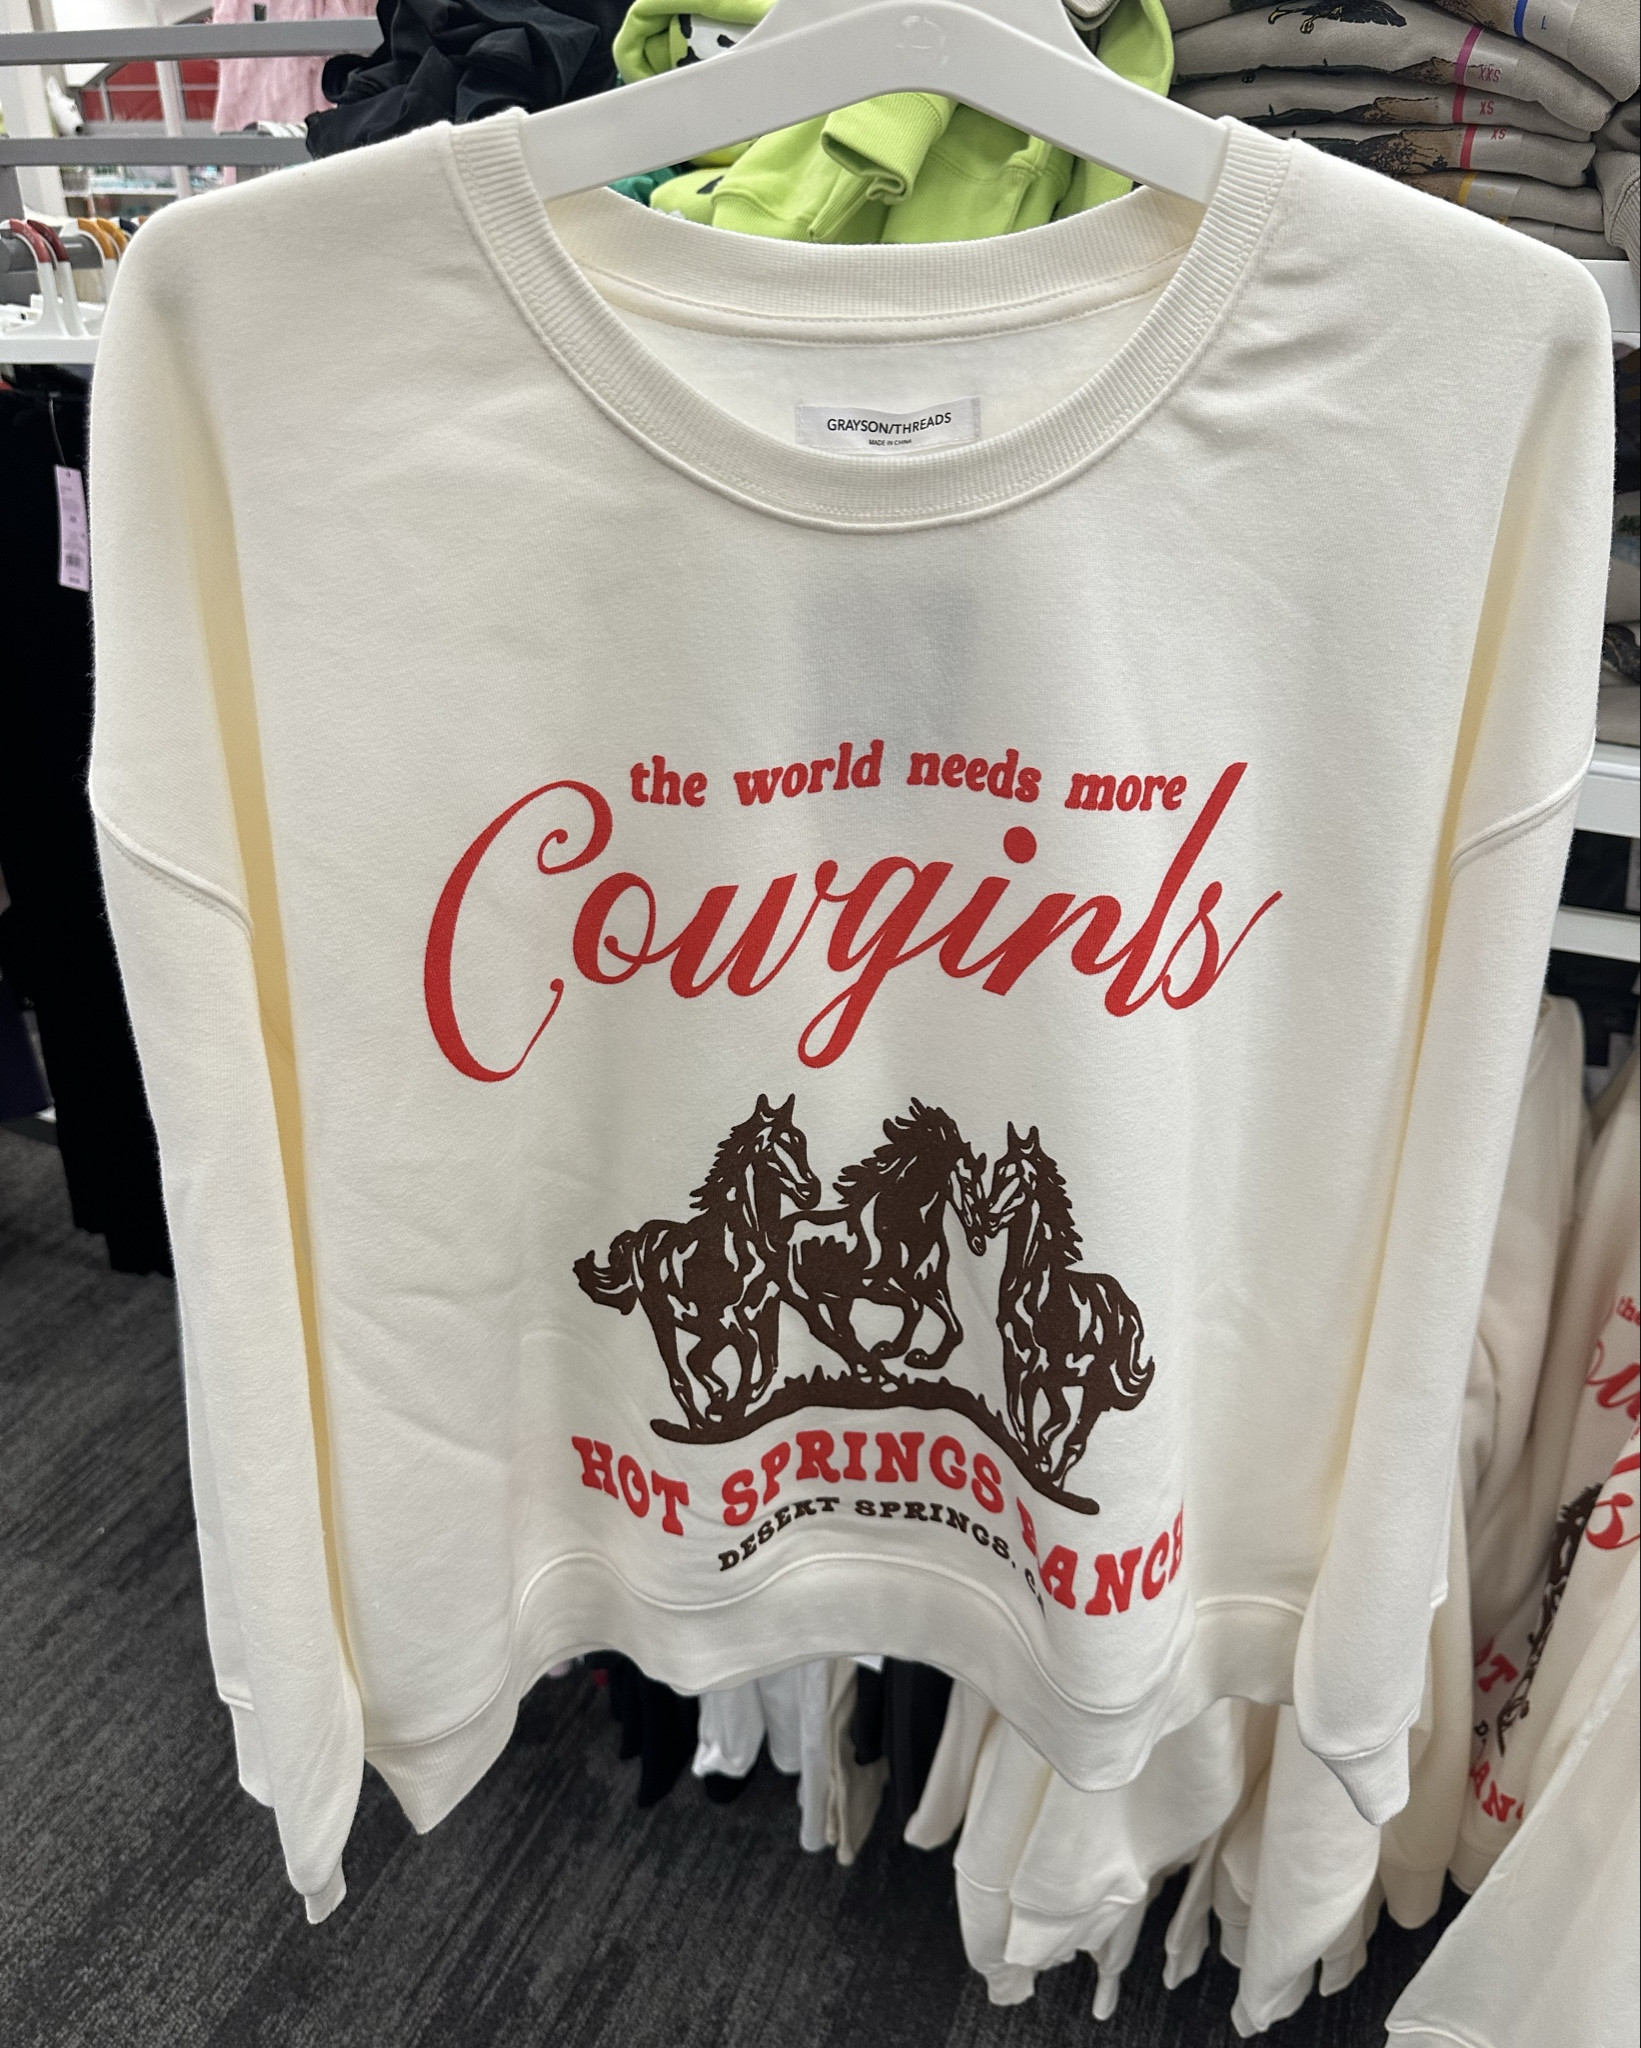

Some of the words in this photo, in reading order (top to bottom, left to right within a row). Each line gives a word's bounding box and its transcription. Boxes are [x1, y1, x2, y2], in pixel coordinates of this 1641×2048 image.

[1479, 66, 1501, 82] XXS
[1480, 100, 1495, 115] XS
[1491, 127, 1508, 140] XS
[827, 412, 952, 434] GRAYSON/THREADS
[868, 438, 886, 446] MADE
[894, 438, 912, 446] CHINA
[630, 754, 708, 807] the
[733, 738, 885, 806] world
[907, 748, 1043, 803] needs
[1064, 772, 1188, 811] more
[423, 761, 1283, 1083] Cowgirls
[572, 1435, 690, 1536] HOT
[721, 1429, 1005, 1527] SPRINGS
[717, 1496, 841, 1572] DESERT
[854, 1499, 1017, 1569] SPRINGS,
